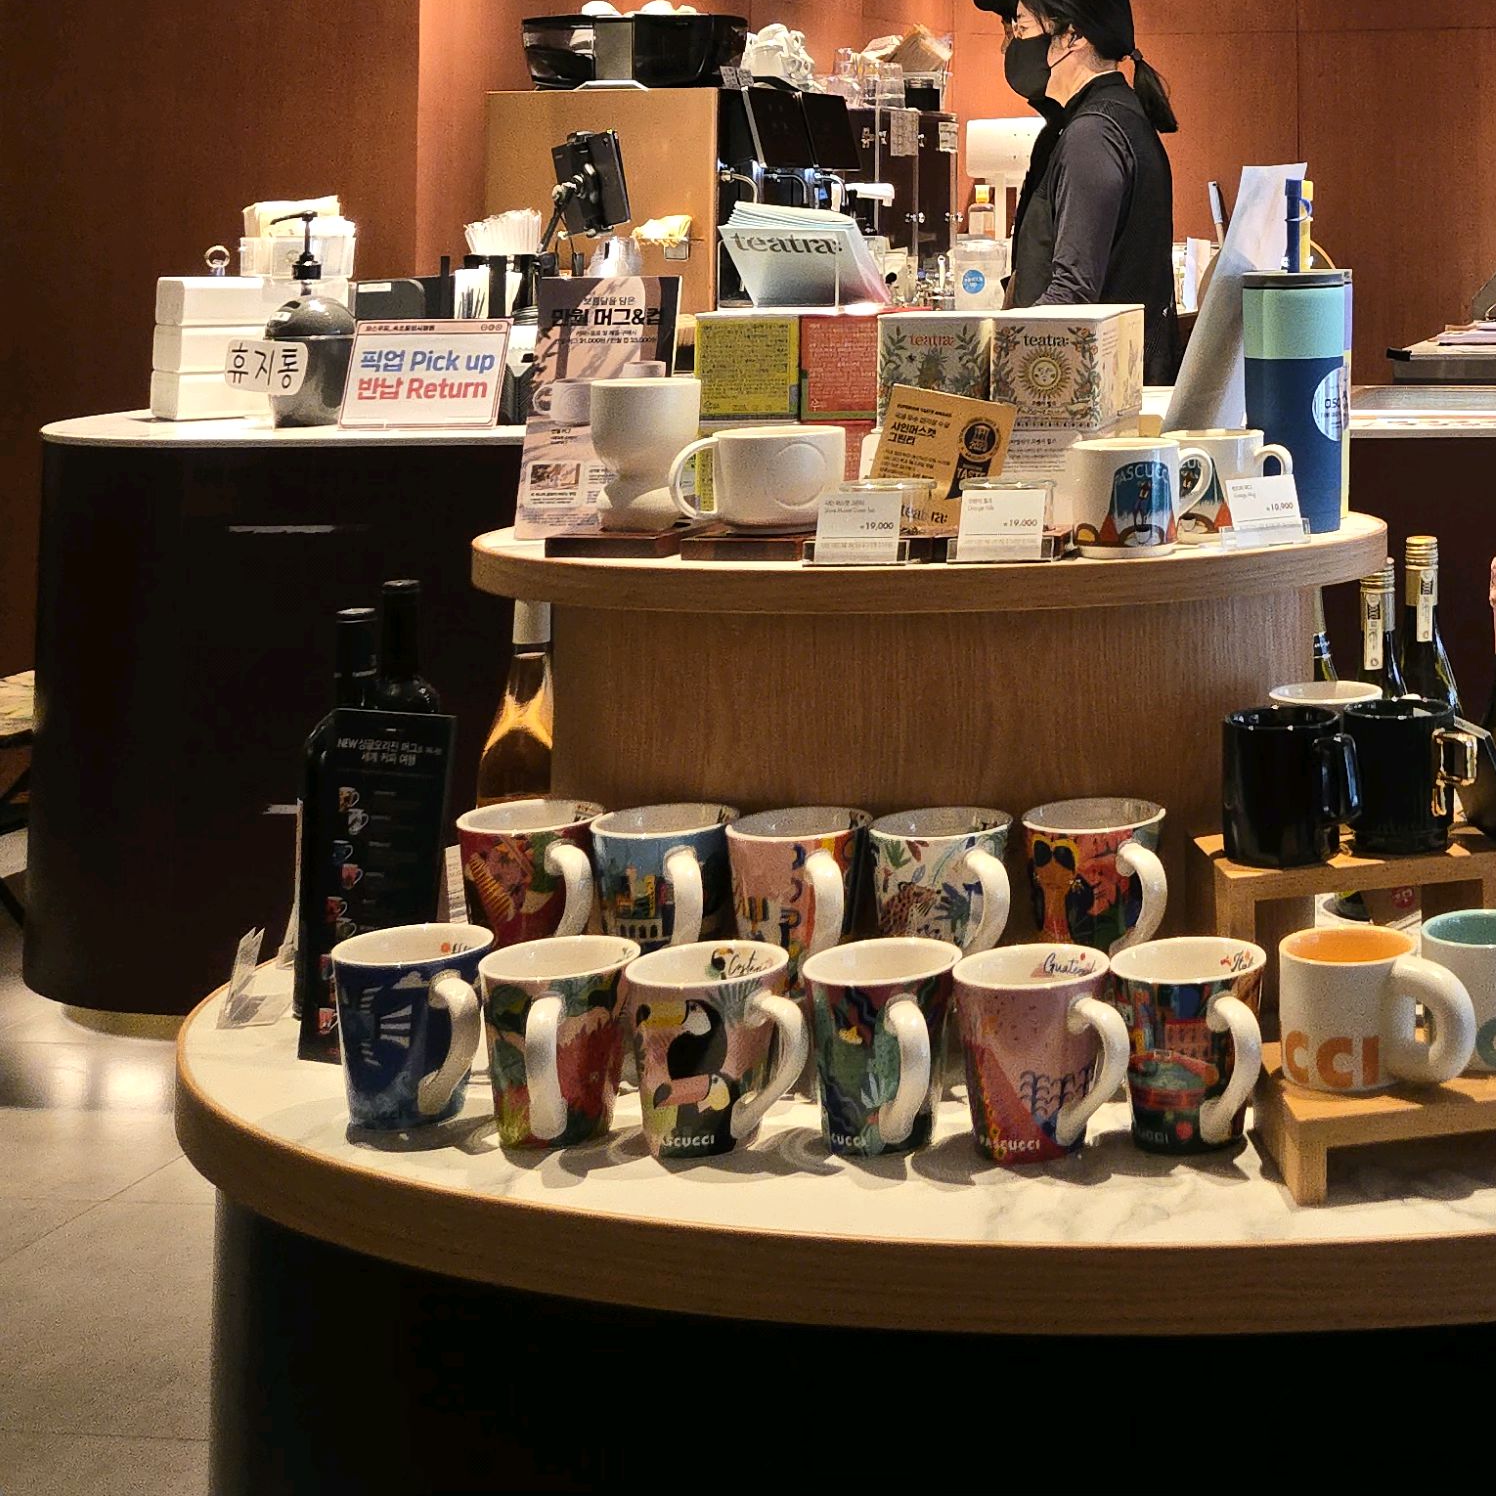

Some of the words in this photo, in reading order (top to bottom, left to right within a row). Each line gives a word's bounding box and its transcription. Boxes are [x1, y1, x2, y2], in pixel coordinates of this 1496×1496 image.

[231, 346, 299, 390] 휴지통
[360, 350, 406, 372] 픽업
[411, 350, 459, 371] Pick
[465, 354, 495, 373] up
[357, 378, 401, 400] 반납
[406, 377, 487, 398] Return
[891, 422, 936, 438] 샤인머스켓
[1285, 1031, 1379, 1088] CCI
